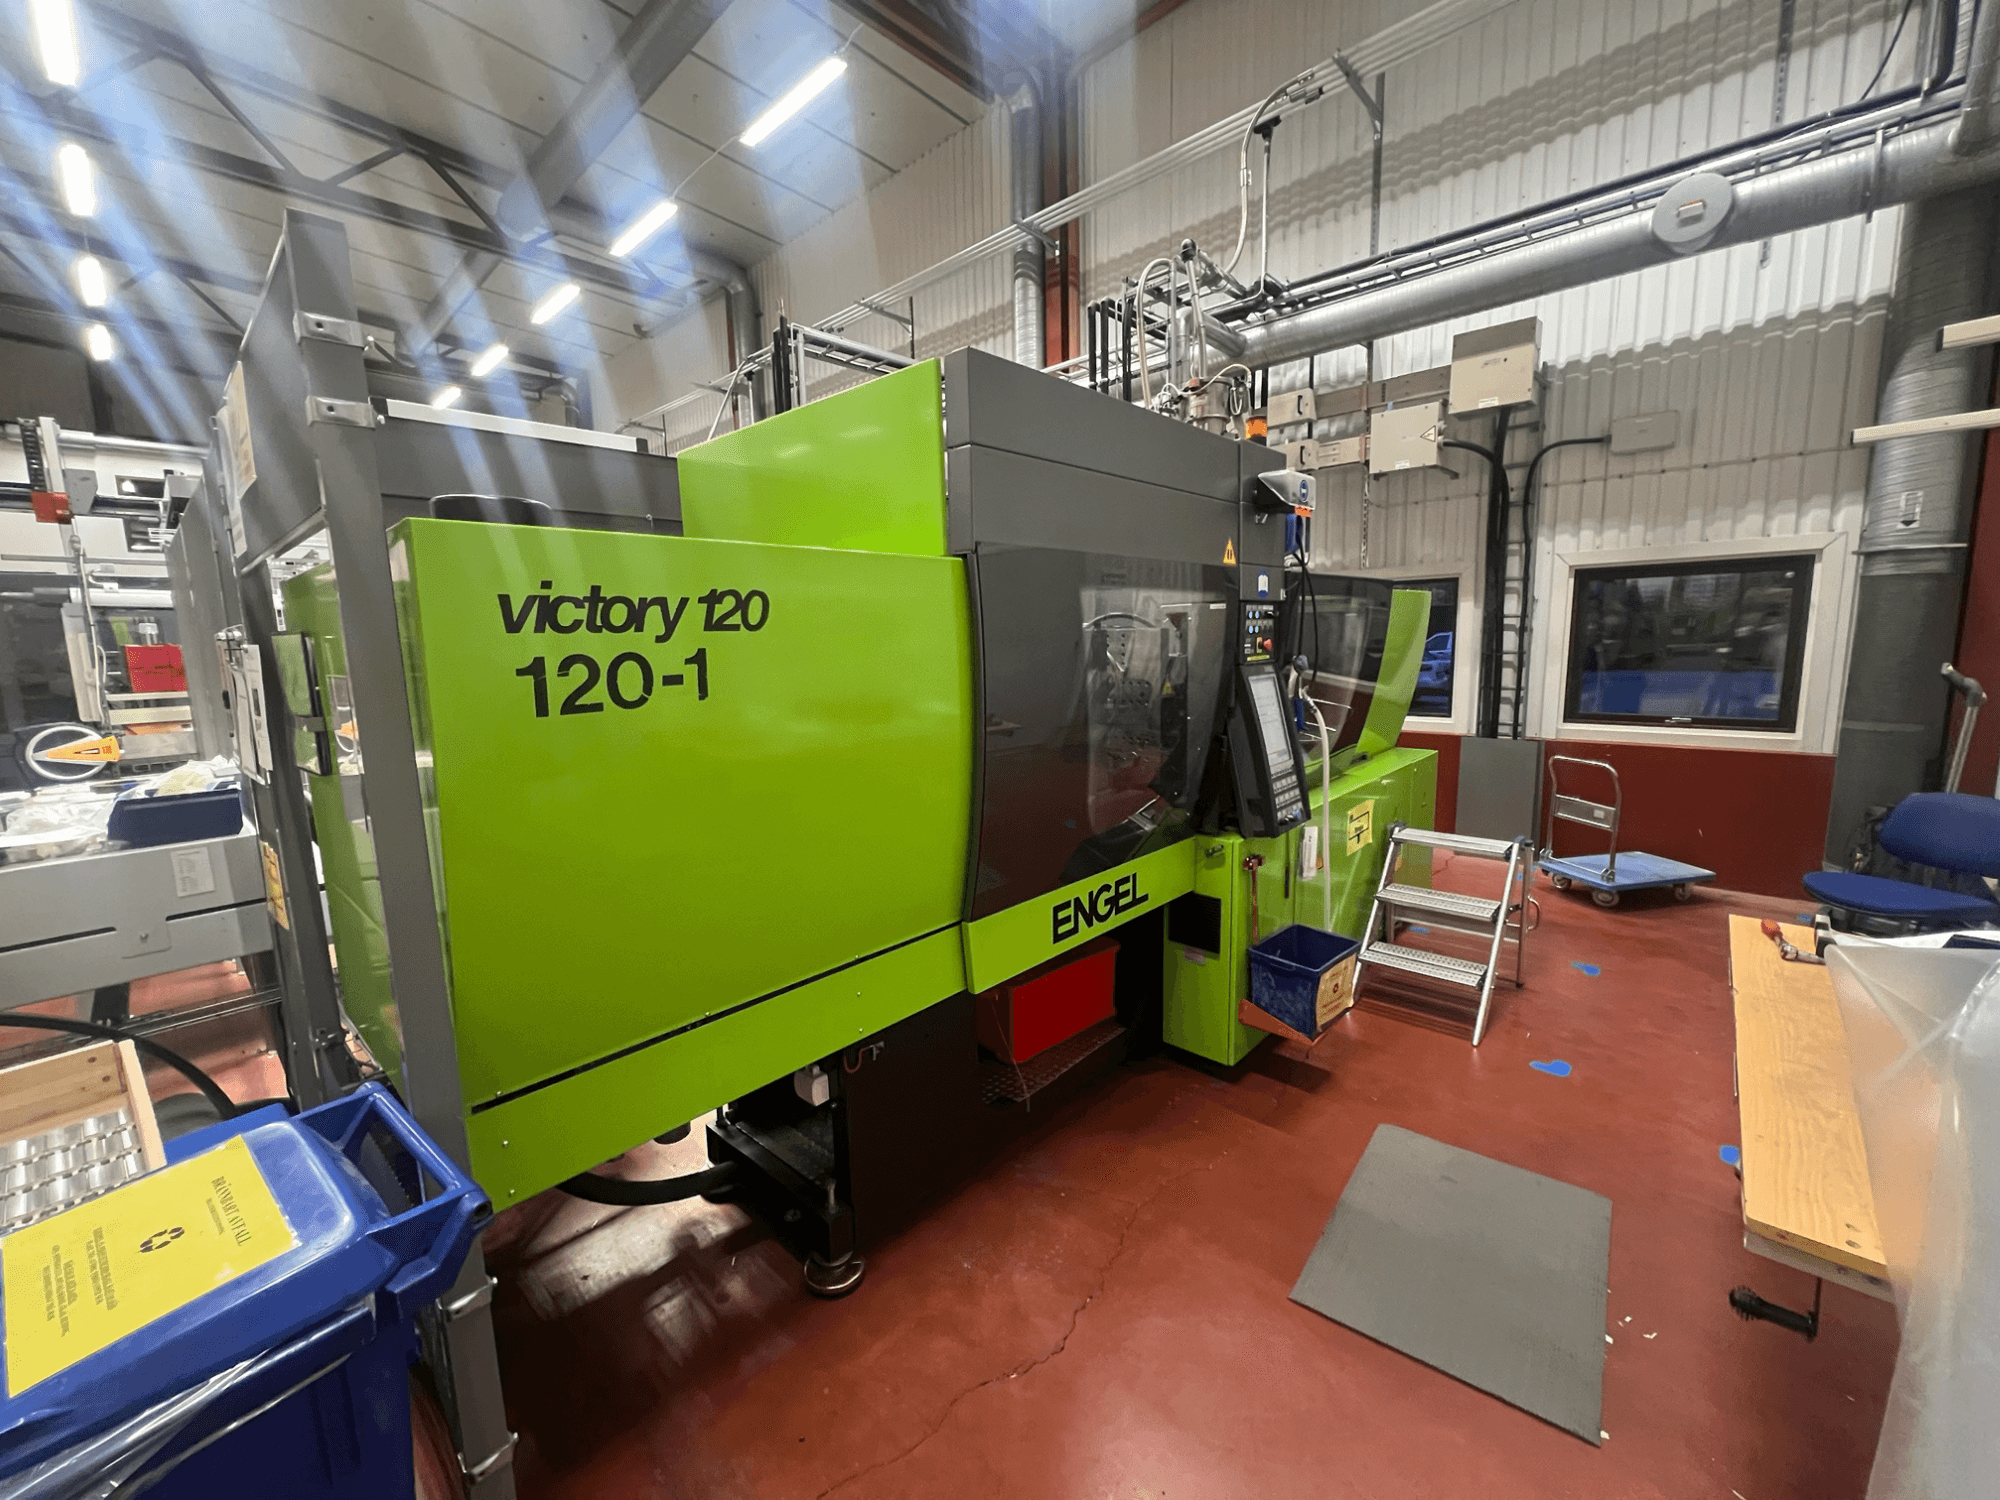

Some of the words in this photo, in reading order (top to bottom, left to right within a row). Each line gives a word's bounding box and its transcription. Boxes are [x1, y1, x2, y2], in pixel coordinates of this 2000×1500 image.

[497, 580, 689, 644] victory
[698, 588, 770, 632] 120
[515, 647, 709, 718] 120-1
[1052, 872, 1149, 944] ENGEL
[226, 1216, 252, 1246] AVFALL
